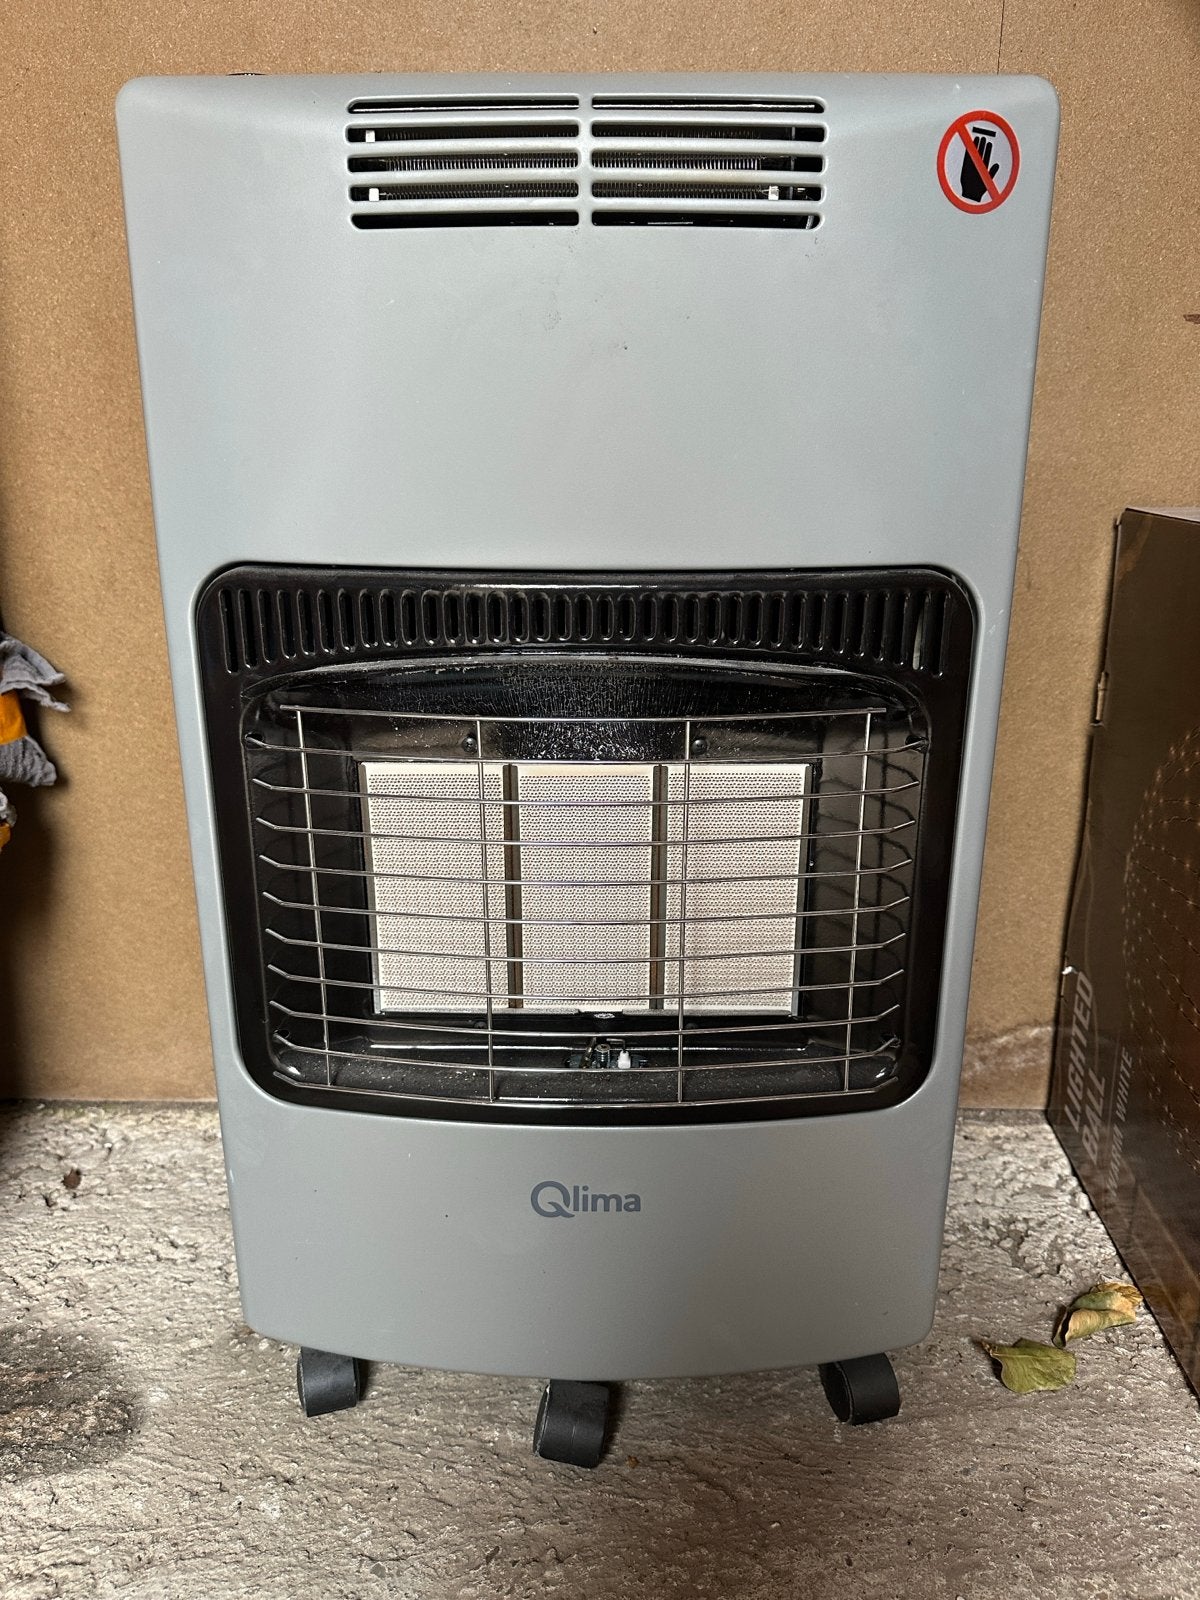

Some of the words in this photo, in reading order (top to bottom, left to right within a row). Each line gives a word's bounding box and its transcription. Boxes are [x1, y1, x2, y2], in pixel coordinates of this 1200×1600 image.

[1064, 971, 1094, 1133] LIGHTED
[1115, 1047, 1133, 1122] WHITE
[1082, 1068, 1106, 1165] BALL
[530, 1180, 642, 1218] Qlima
